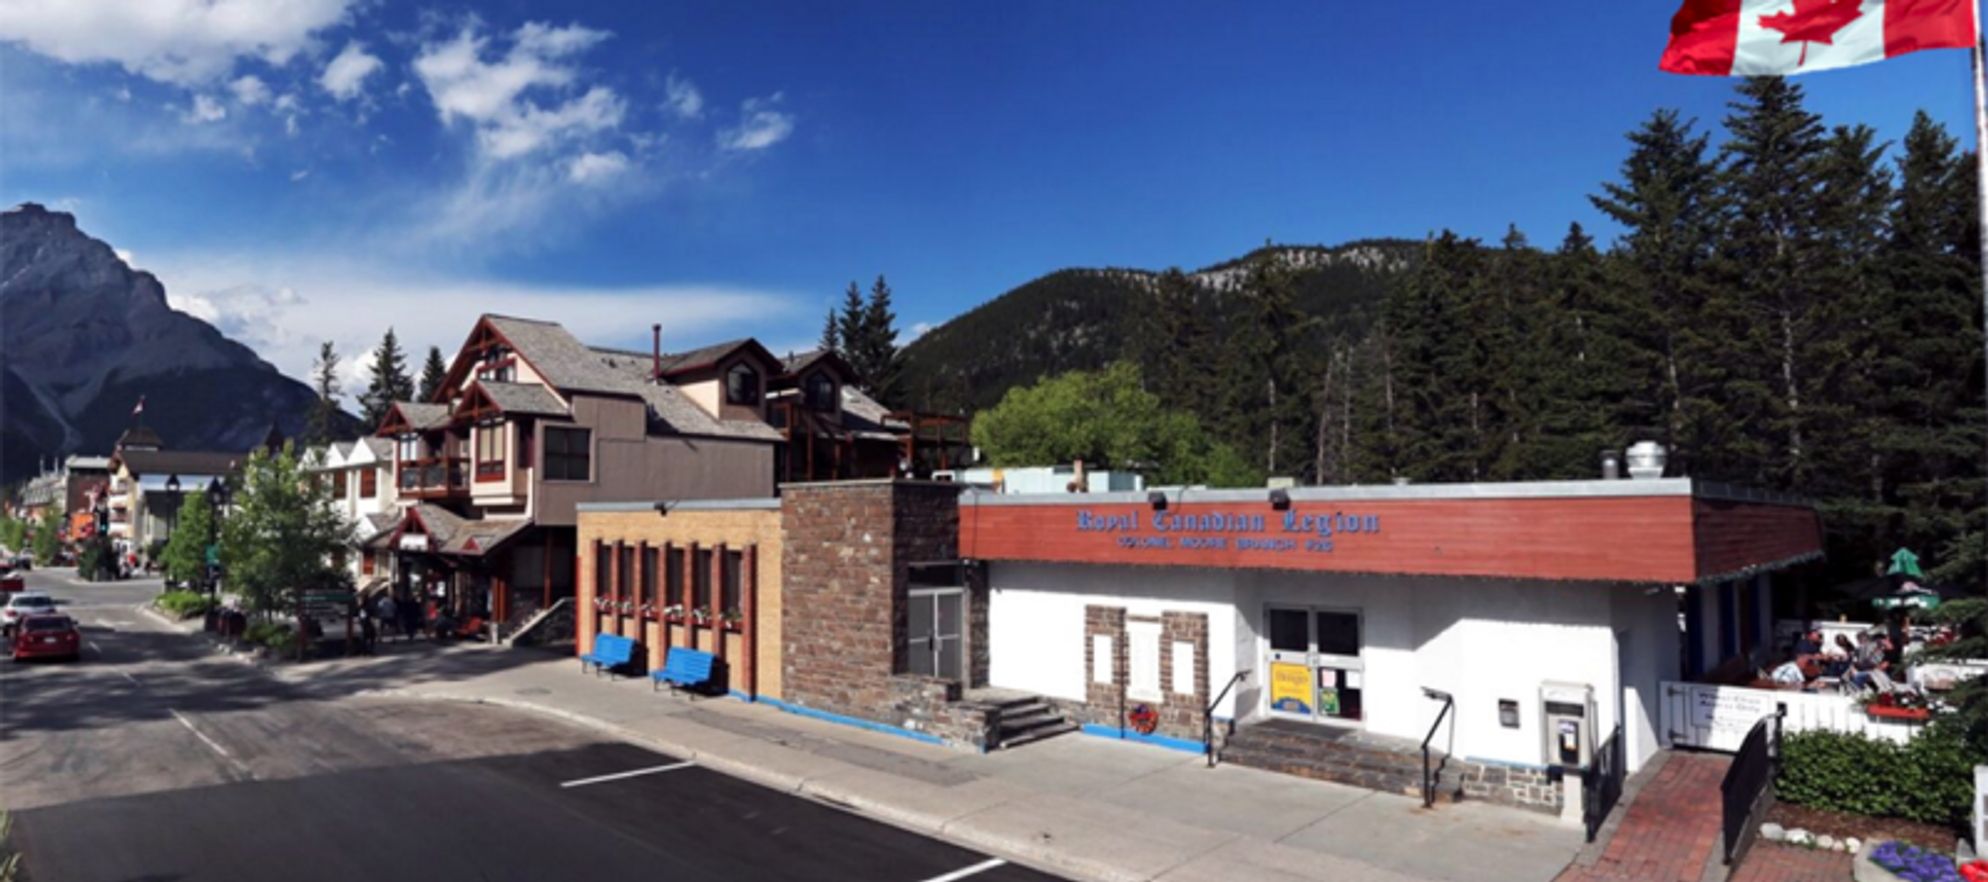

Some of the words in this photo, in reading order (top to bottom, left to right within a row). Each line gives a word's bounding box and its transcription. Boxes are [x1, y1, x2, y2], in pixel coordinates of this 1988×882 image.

[1077, 510, 1139, 532] Royal
[1153, 510, 1265, 532] Canadian
[1283, 509, 1379, 537] Legion
[1180, 537, 1227, 549] MOORE
[1235, 537, 1297, 550] BRANCH
